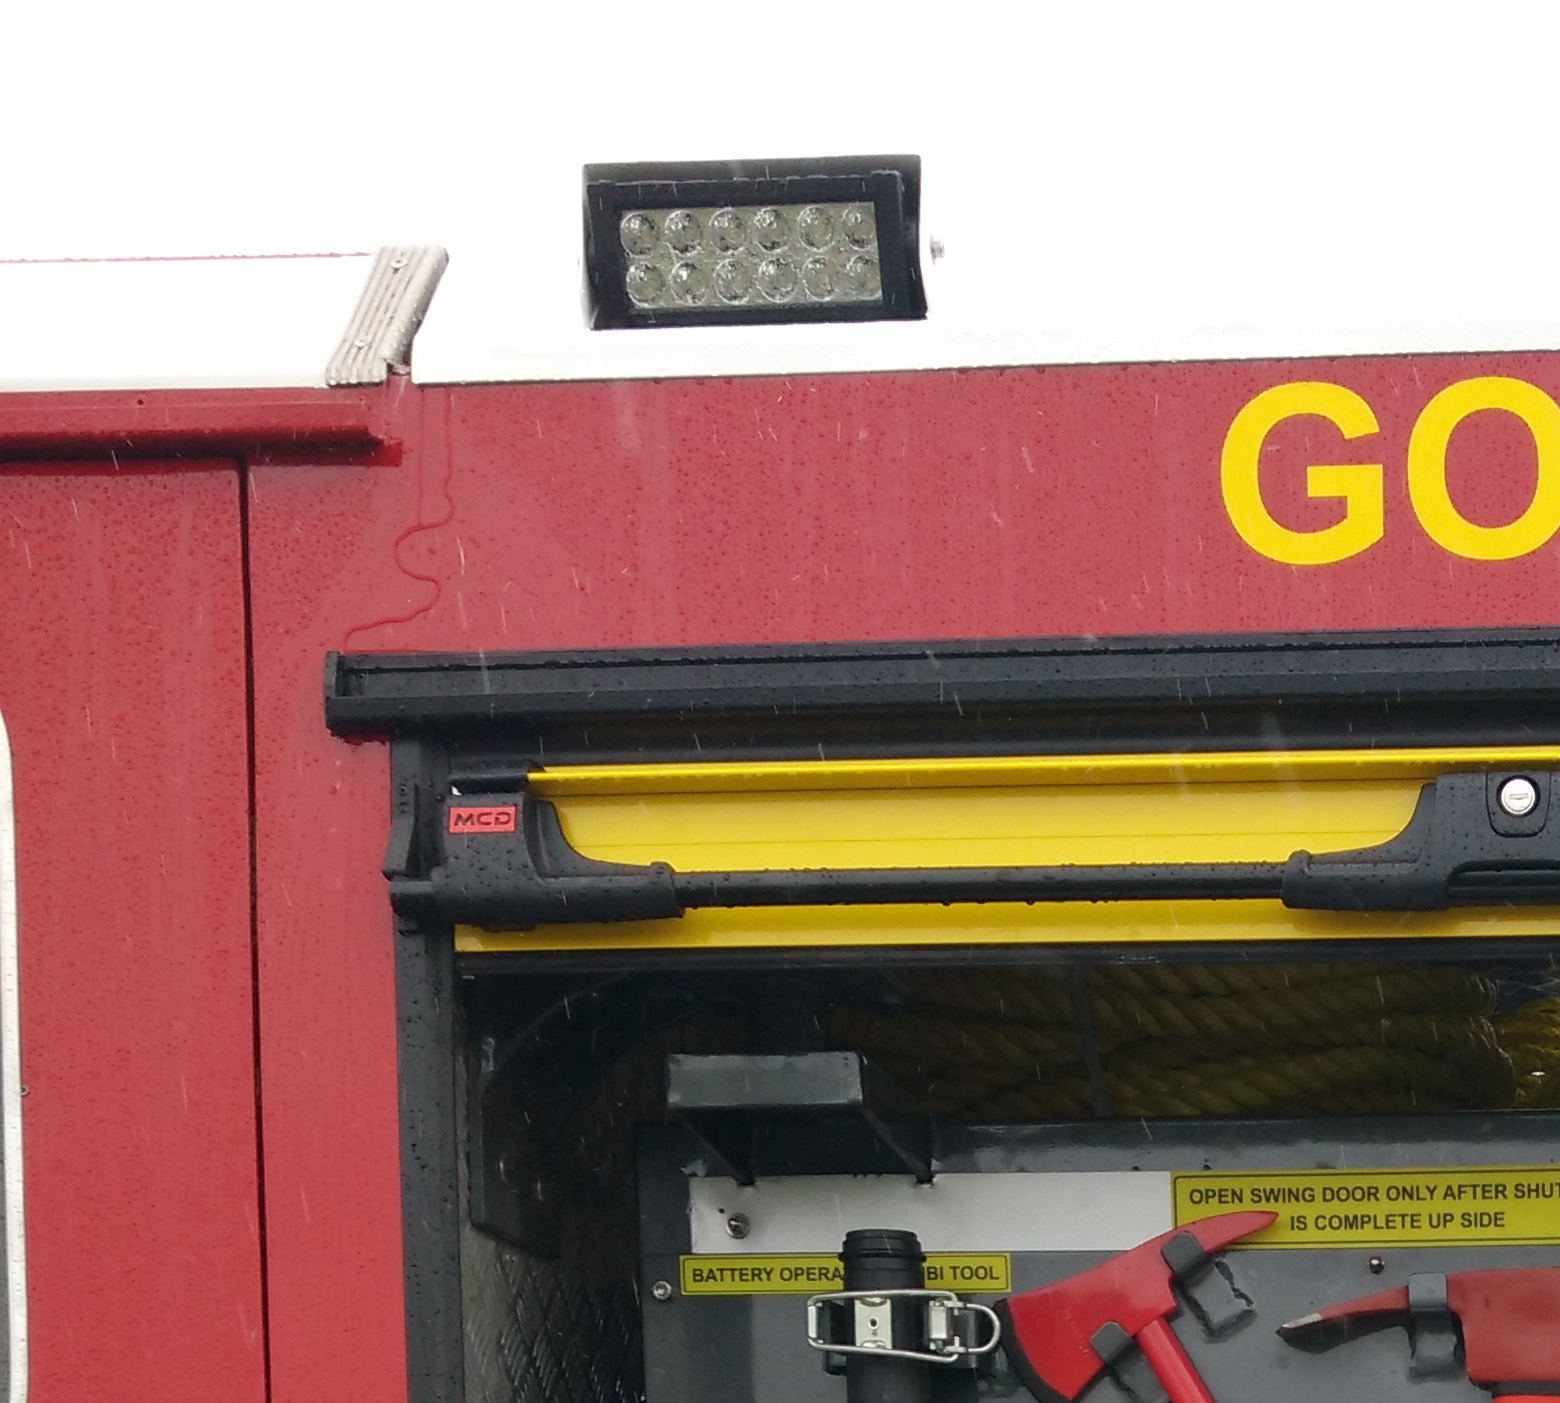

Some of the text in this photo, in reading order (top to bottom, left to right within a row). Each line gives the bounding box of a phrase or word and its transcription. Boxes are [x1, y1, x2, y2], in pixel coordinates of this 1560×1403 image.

[453, 812, 511, 826] MCD
[1189, 1187, 1245, 1204] OPEN
[1250, 1186, 1316, 1203] SWING
[1322, 1185, 1379, 1202] DOOR
[1386, 1184, 1438, 1201] ONLY
[1442, 1183, 1507, 1200] AFTER
[1290, 1211, 1506, 1231] IS COMPLETE UP SIDE
[692, 1266, 774, 1283] BATTERY
[779, 1265, 845, 1282] OPERA
[952, 1265, 1000, 1280] TOOL
